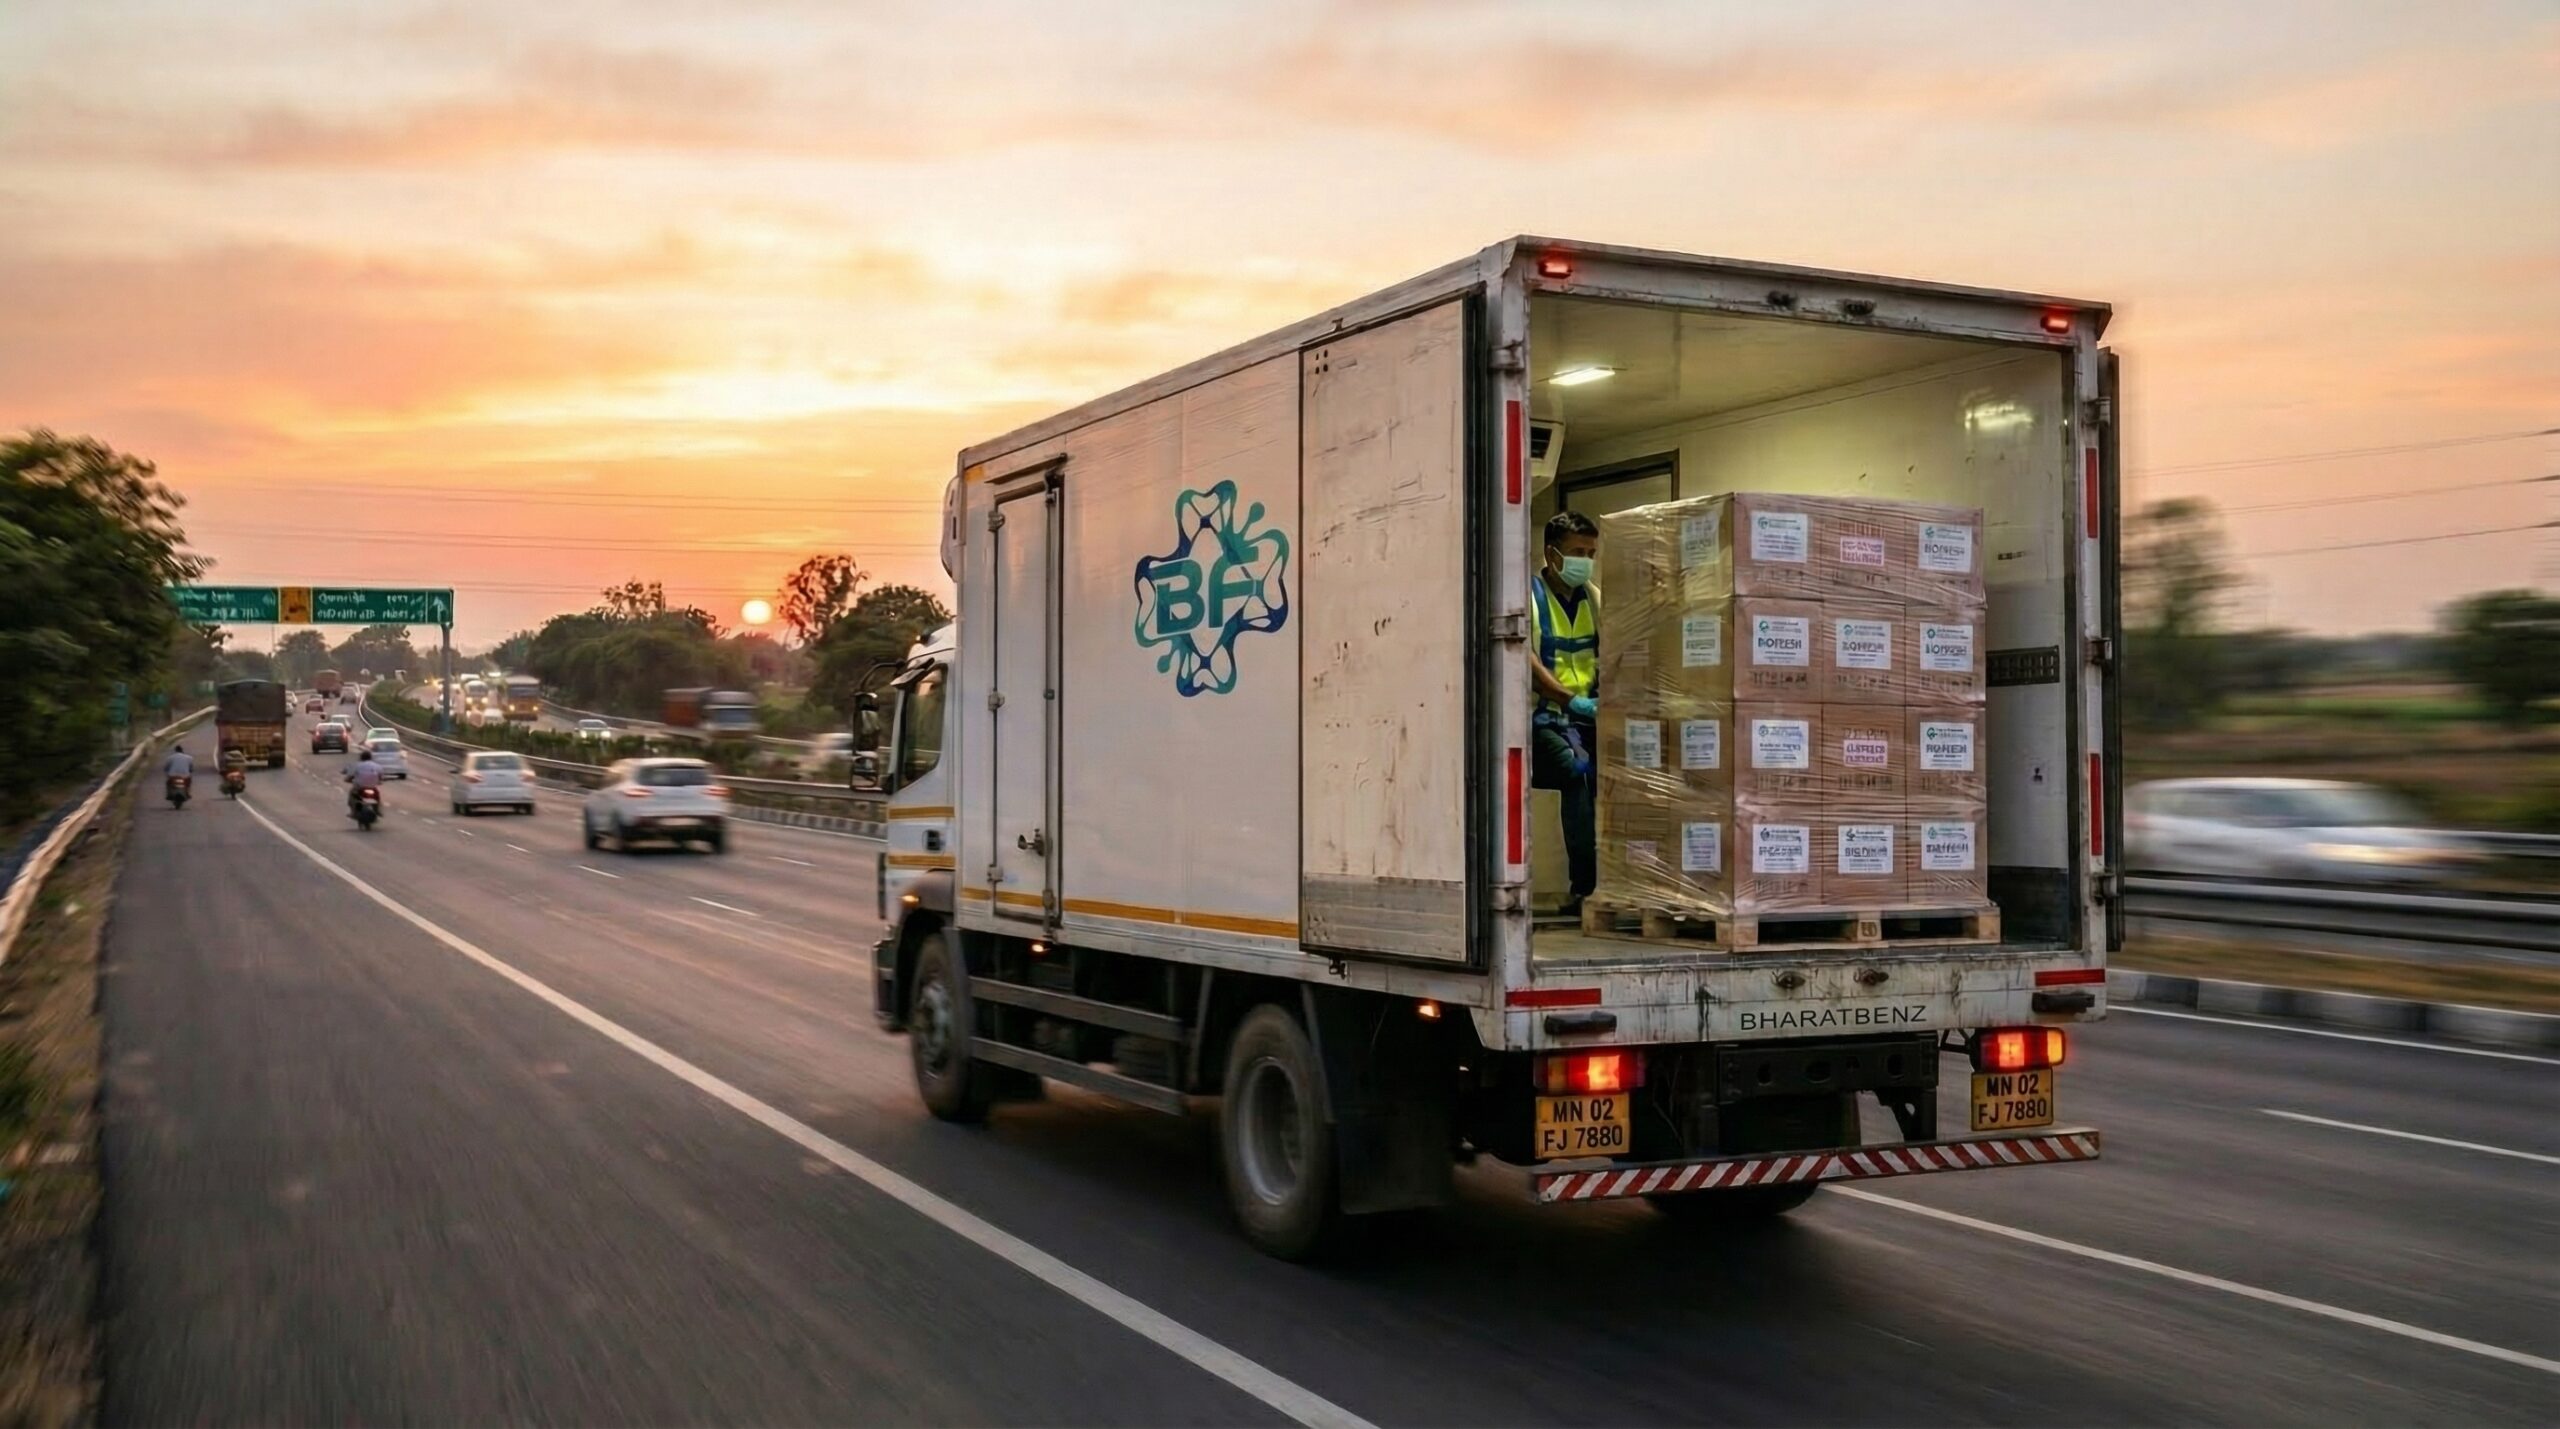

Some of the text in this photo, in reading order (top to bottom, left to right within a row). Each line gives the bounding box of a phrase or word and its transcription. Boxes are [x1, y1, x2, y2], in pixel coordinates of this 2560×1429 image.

[1151, 545, 1264, 634] BF
[1740, 1005, 1927, 1030] BHARATBENZ
[1986, 1074, 2039, 1096] MN 02
[1553, 1098, 1614, 1122] MN 02
[1978, 1098, 2047, 1124] FJ 7880
[1544, 1125, 1623, 1151] FJ 7880
